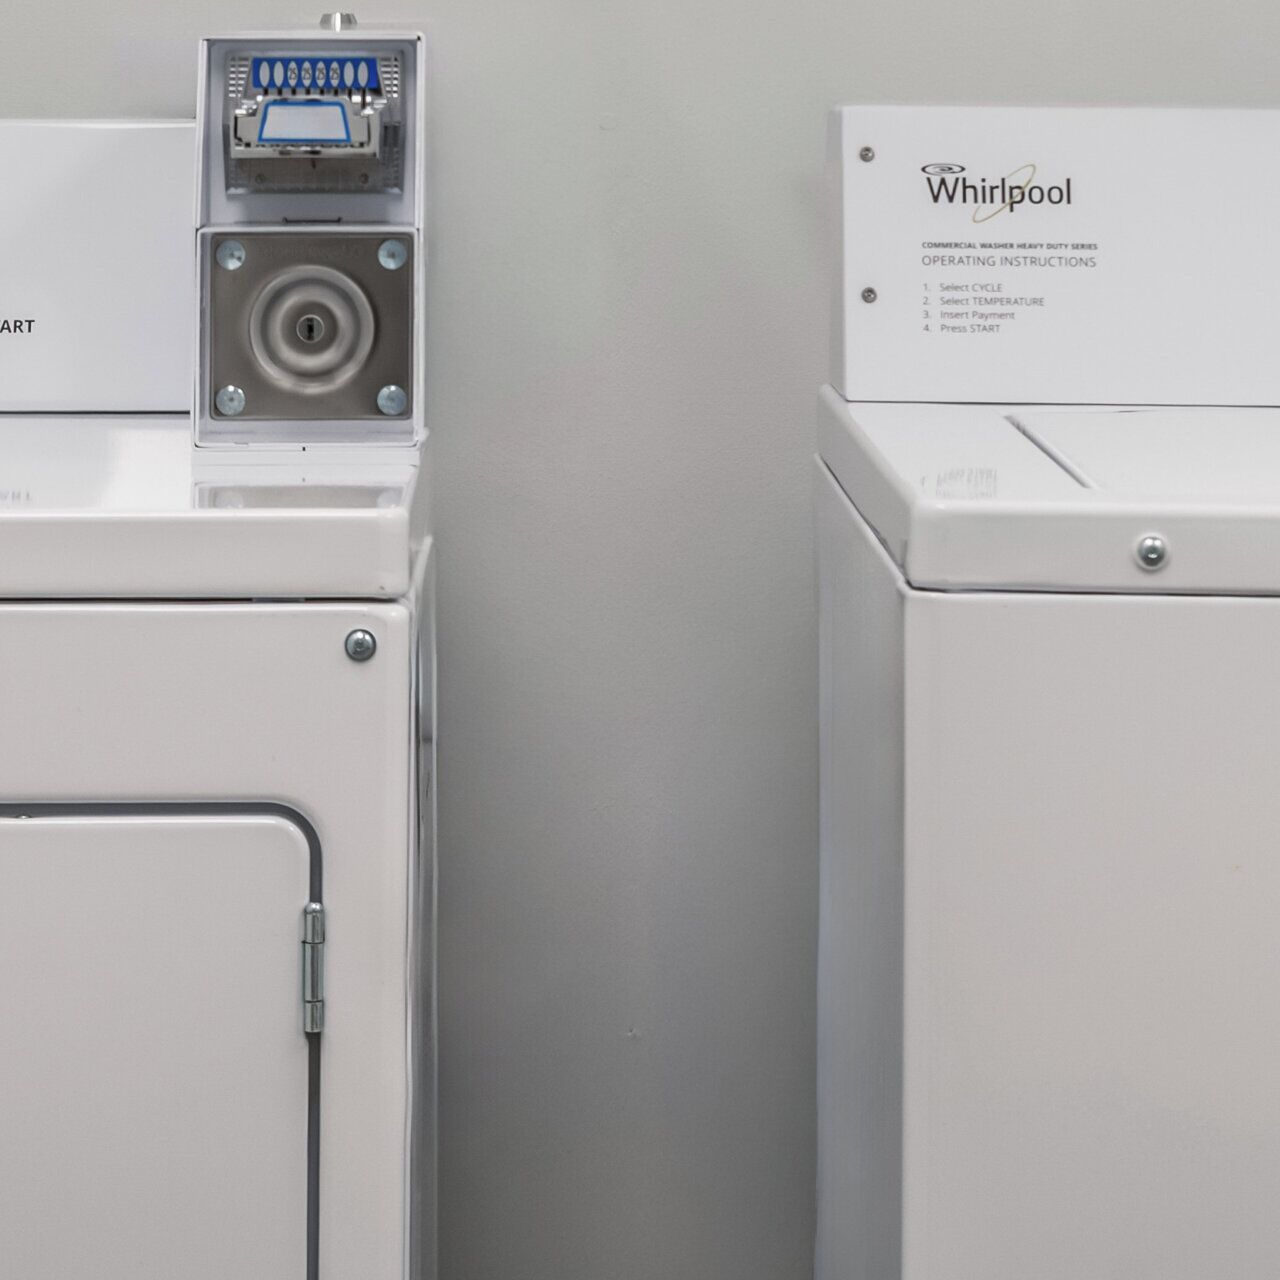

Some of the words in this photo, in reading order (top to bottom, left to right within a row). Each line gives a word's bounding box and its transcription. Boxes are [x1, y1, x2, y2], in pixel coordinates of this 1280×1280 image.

[926, 177, 1073, 213] Whirlpool
[921, 241, 978, 250] COMMERCIAL
[980, 242, 1015, 250] WASHER
[1017, 242, 1044, 250] HEAVY
[1071, 243, 1099, 251] SERIES
[921, 255, 996, 268] OPERATING
[1000, 256, 1096, 268] INSTRUCTIONS
[940, 283, 970, 292] Select
[971, 283, 1003, 293] CYCLE
[940, 297, 970, 306] Select
[972, 297, 1045, 307] TEMPERATURE
[940, 311, 970, 320] Insert
[972, 311, 1016, 322] Payment
[940, 324, 968, 333] Press
[970, 324, 1001, 334] START
